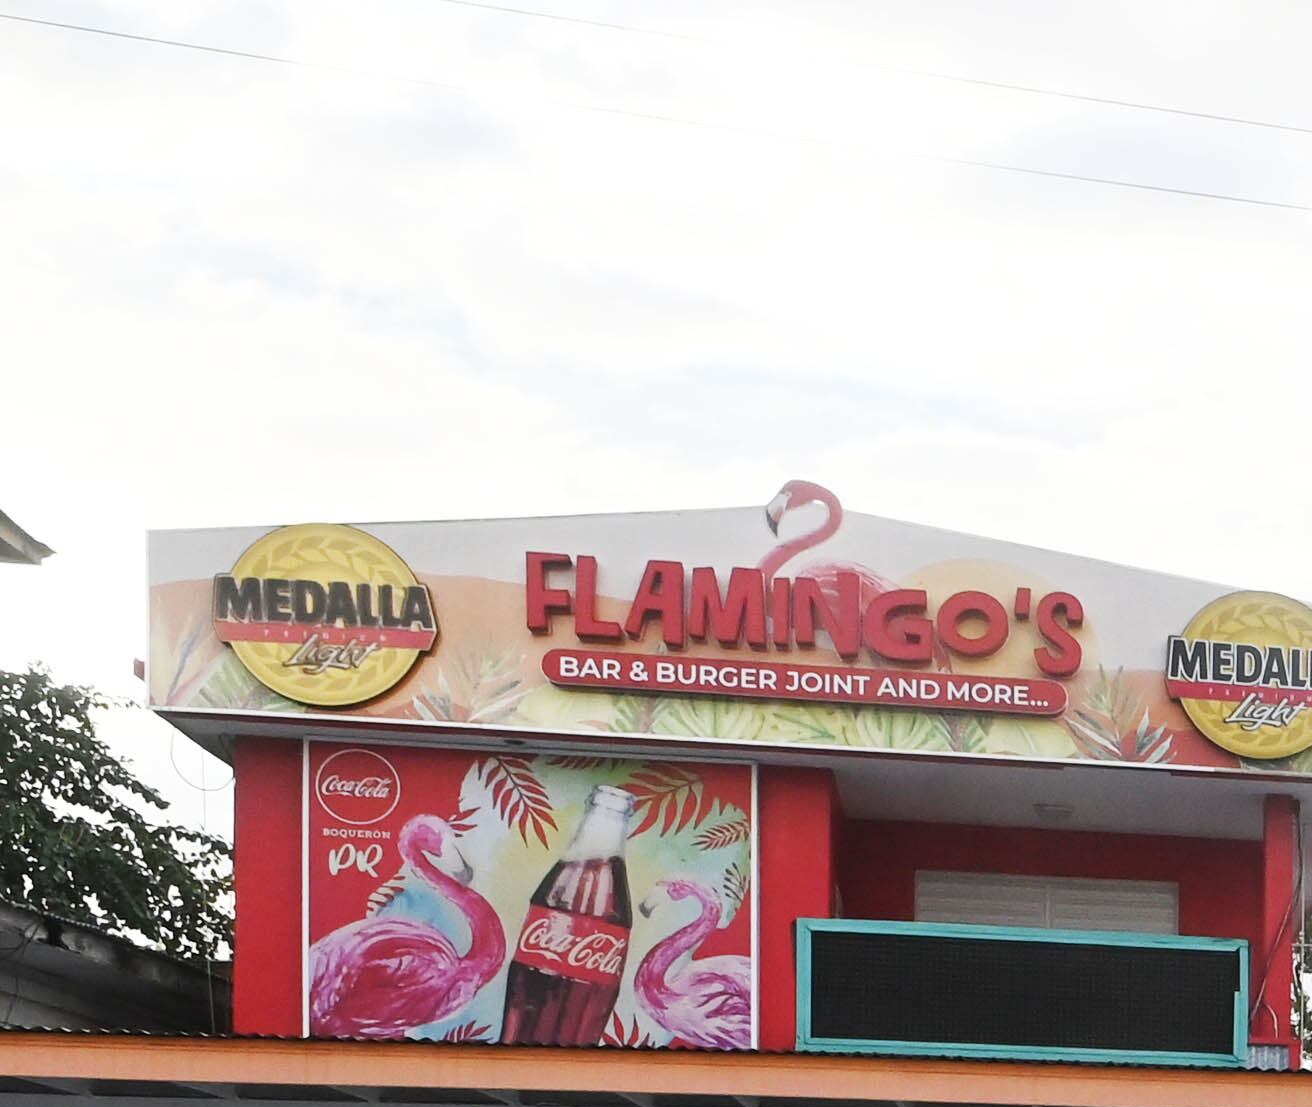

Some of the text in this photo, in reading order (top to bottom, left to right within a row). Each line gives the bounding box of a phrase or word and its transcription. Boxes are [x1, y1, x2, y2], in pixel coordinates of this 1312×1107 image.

[216, 576, 433, 630] MEDALLA
[525, 551, 1085, 676] FLAMINGO'S
[282, 633, 379, 674] Light
[559, 655, 1050, 708] BAR & BURGER JOINT AND MORE...
[1224, 692, 1306, 732] Light
[328, 842, 384, 878] PR
[520, 918, 626, 976] Coca-Cola
